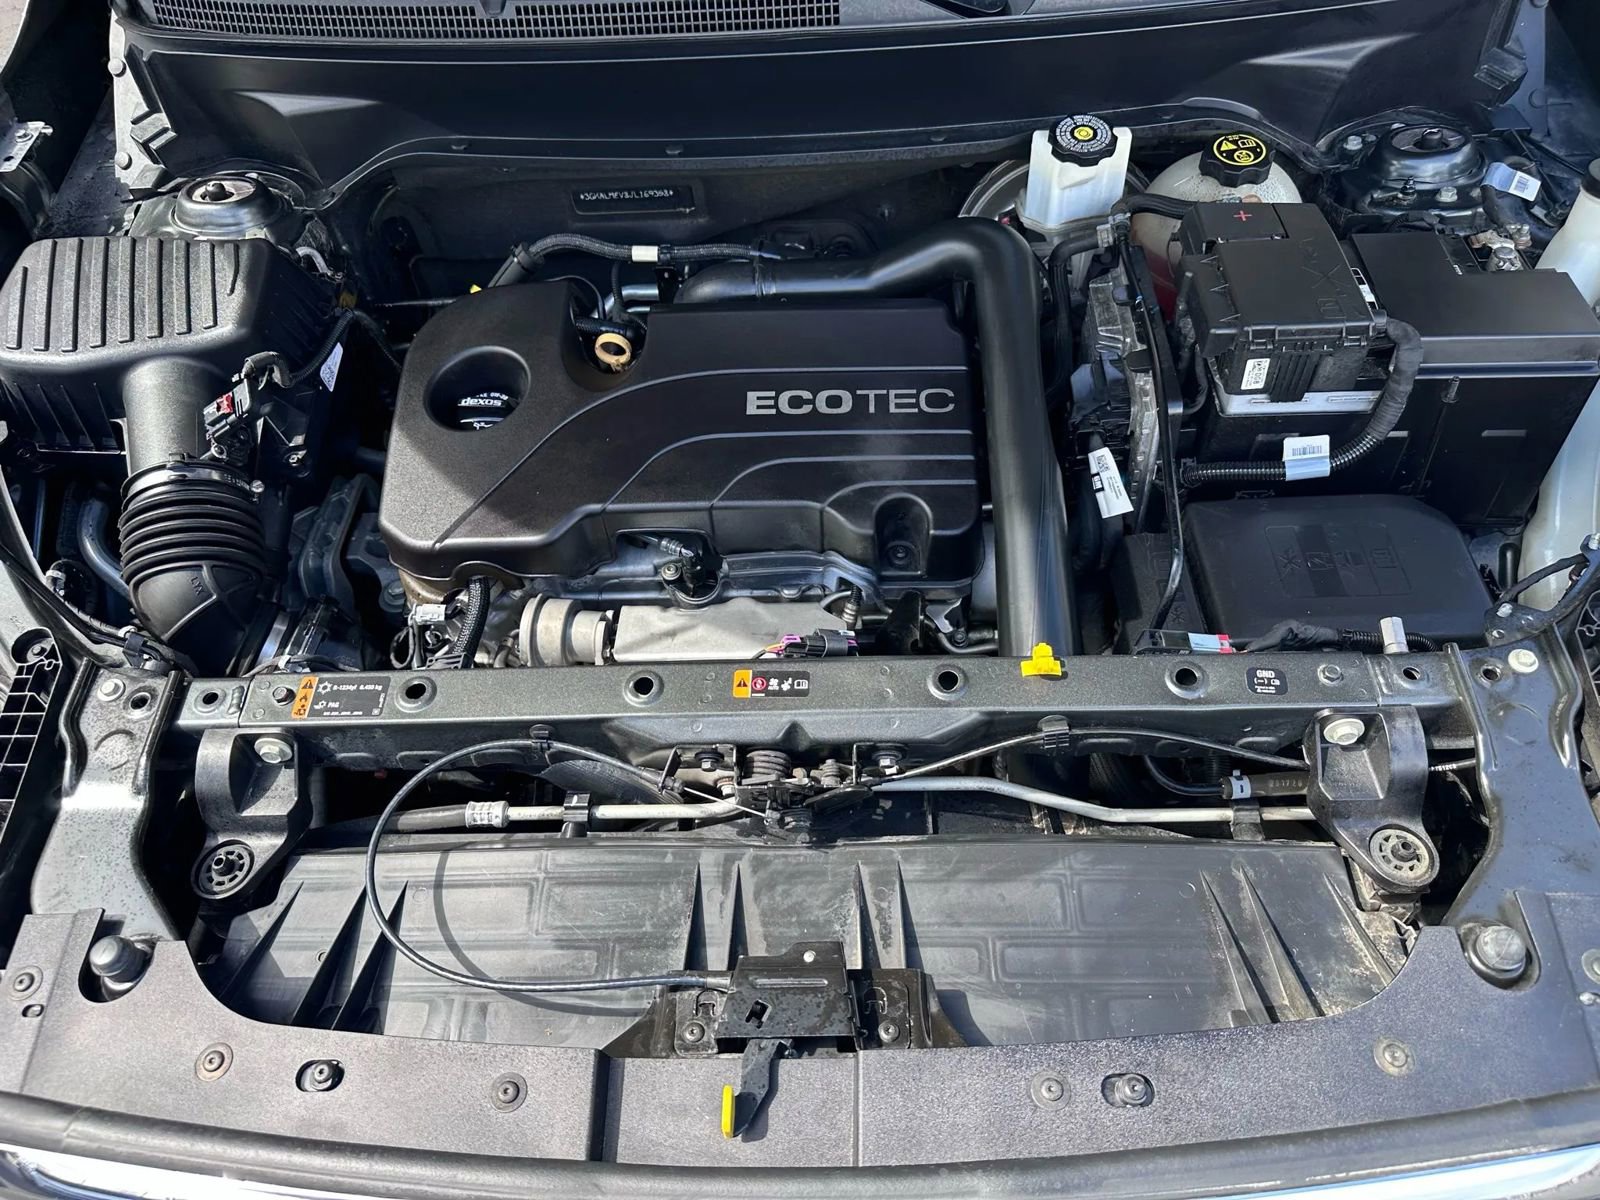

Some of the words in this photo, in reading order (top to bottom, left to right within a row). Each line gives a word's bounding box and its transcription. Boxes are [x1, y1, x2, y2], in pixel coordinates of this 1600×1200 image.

[461, 397, 502, 407] dexos
[746, 388, 955, 415] ECOTEC
[1256, 669, 1276, 678] GND
